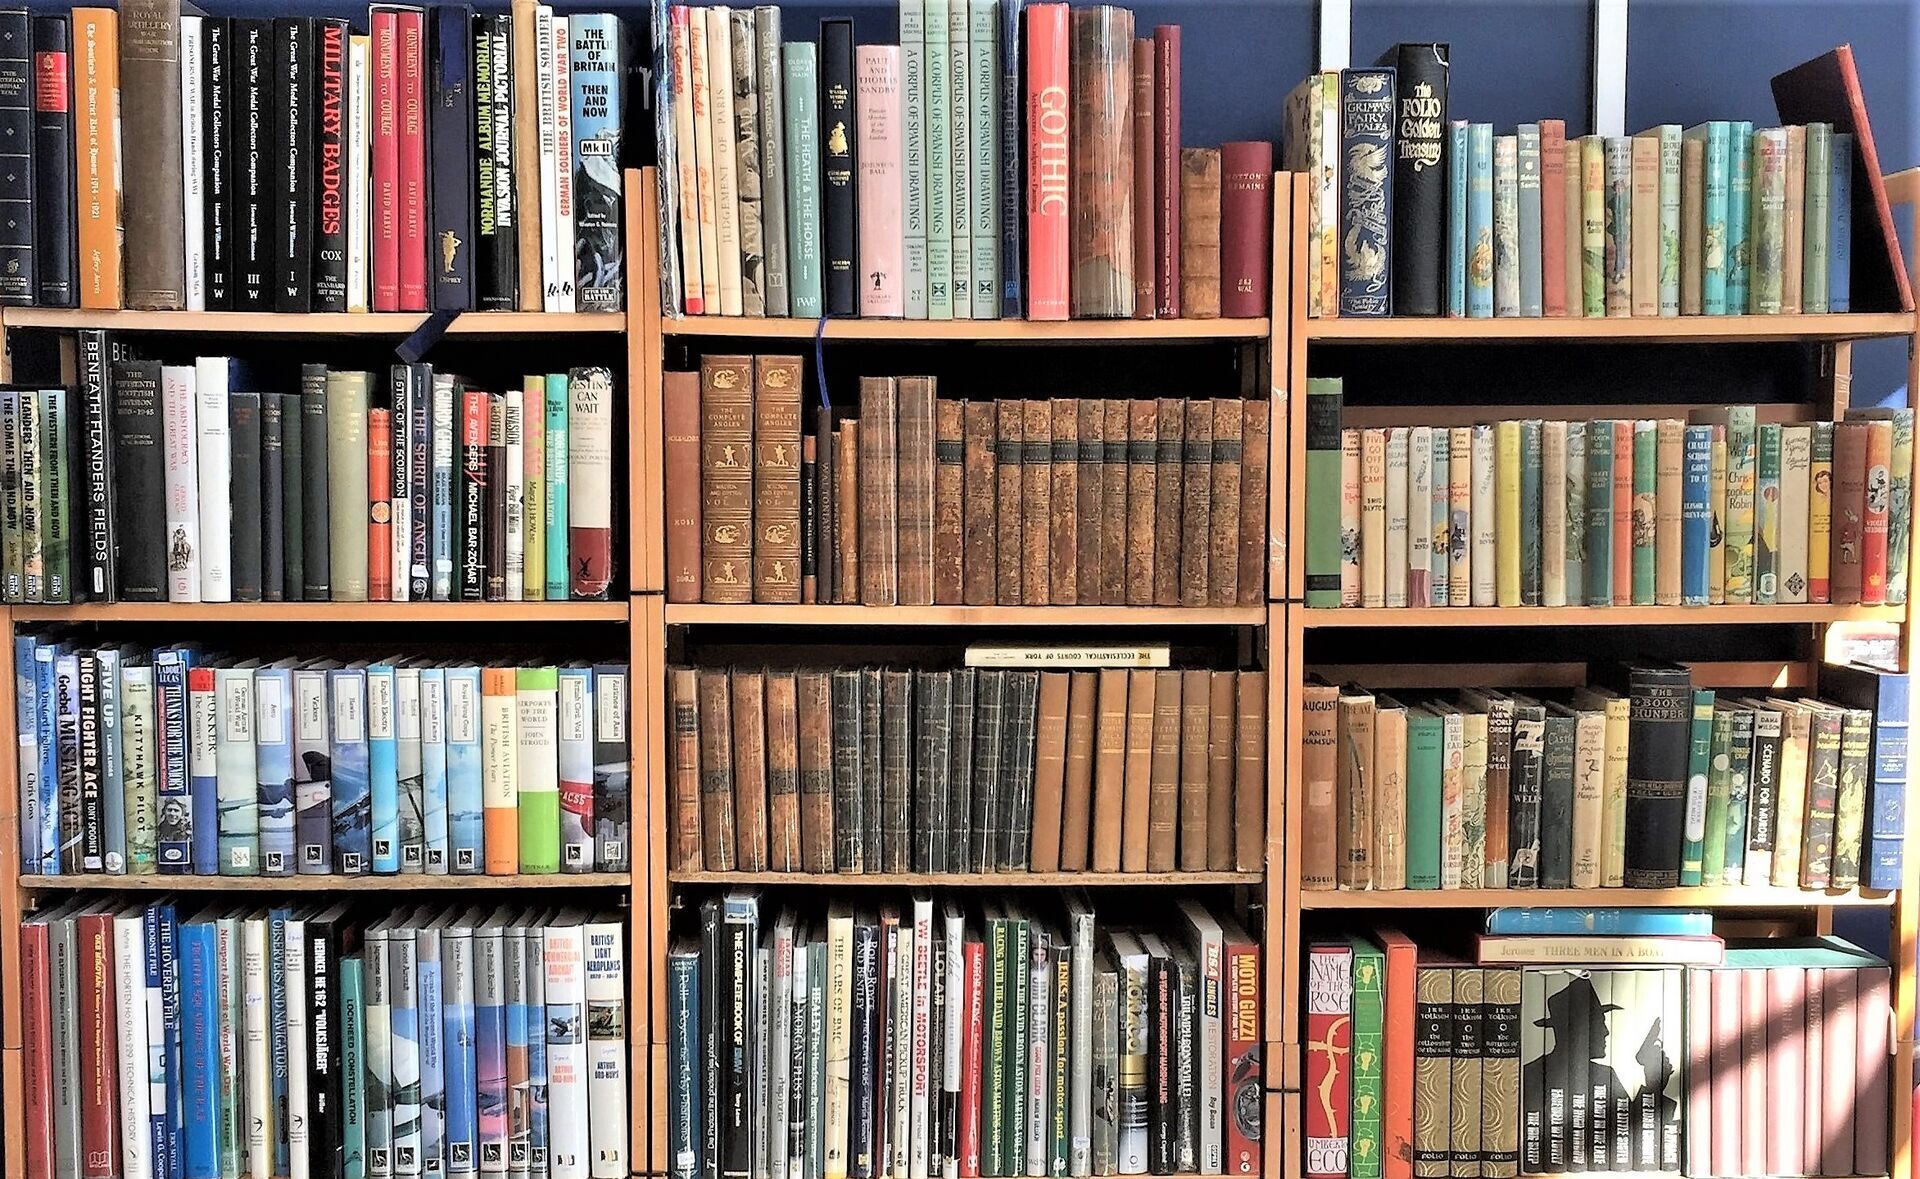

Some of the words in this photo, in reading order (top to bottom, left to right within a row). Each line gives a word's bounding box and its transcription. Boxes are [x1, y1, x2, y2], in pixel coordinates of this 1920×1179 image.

[540, 15, 549, 67] SOLDIER
[557, 29, 566, 49] TWO
[584, 29, 603, 39] THE
[476, 31, 490, 103] MEMORIAL
[494, 32, 508, 102] PICTORIAL
[558, 54, 566, 74] WAR
[574, 62, 615, 72] BRITAIN
[588, 51, 600, 60] OF
[323, 28, 341, 135] MILITARY
[582, 85, 608, 94] THEN
[908, 60, 918, 102] CORPUS
[1415, 81, 1431, 97] The
[542, 74, 551, 124] BRITISH
[558, 79, 567, 111] WORLD
[585, 96, 606, 105] AND
[1402, 98, 1441, 117] FOLIO
[559, 116, 568, 127] OF
[583, 108, 607, 117] NOW
[908, 106, 918, 117] OF
[1349, 113, 1385, 124] FAIRY
[479, 105, 492, 150] ALBUM
[496, 106, 509, 166] JOURNAL
[800, 119, 810, 140] THE
[1357, 123, 1387, 131] TALES
[1402, 118, 1442, 138] Golden
[544, 130, 552, 152] THE
[559, 131, 568, 173] SOLDIERS
[583, 143, 600, 153] Mk
[909, 122, 918, 166] SPANISH
[1040, 86, 1067, 216] GOTHIC
[801, 144, 811, 181] HEATH
[1399, 140, 1441, 171] Treasury
[213, 150, 221, 194] Companion
[324, 144, 340, 233] BADGES
[480, 157, 494, 235] NORMANDIE
[497, 168, 510, 226] INVASION
[560, 177, 569, 216] GERMAN
[910, 171, 919, 229] DRAWINGS
[804, 197, 812, 218] THE
[802, 222, 813, 259] HORSE
[321, 251, 342, 260] COX
[88, 342, 101, 414] BENEATH
[396, 382, 404, 410] STING
[469, 396, 477, 414] THE
[575, 403, 599, 413] WAIT
[578, 392, 598, 401] CAN
[22, 396, 32, 444] FLANDERS
[396, 413, 404, 425] OF
[415, 407, 426, 435] THE
[507, 406, 519, 445] INVASION
[468, 418, 477, 471] AVENGERS
[24, 451, 33, 474] THEN
[91, 420, 104, 502] FLANDERS
[415, 442, 426, 487] SPIRIT
[25, 482, 34, 501] AND
[415, 493, 426, 513] OF
[468, 482, 478, 524] MICHAEL
[1730, 498, 1751, 509] Robin
[25, 508, 34, 530] NOW
[94, 509, 106, 560] FIELDS
[82, 658, 94, 701] NIGHT
[102, 662, 112, 700] FIVE
[58, 675, 72, 716] Goebel
[166, 686, 183, 719] THANKS
[1303, 701, 1335, 711] AUGUST
[1641, 699, 1679, 707] BOOK
[104, 704, 114, 727] UP
[1635, 709, 1684, 718] HUNTER
[83, 708, 95, 766] FIGHTER
[167, 720, 183, 737] FOR
[61, 720, 78, 796] MUSTANG
[135, 713, 143, 788] KITTYHAWK
[168, 738, 183, 754] THE
[168, 756, 184, 791] MEMORY
[1761, 744, 1772, 784] SCENARIO
[27, 773, 35, 796] Chris
[85, 772, 97, 797] ACE
[1760, 788, 1769, 804] FOR
[160, 921, 171, 942] THE
[734, 931, 743, 950] THE
[919, 920, 927, 939] VW
[315, 938, 325, 974] HEINKEL
[835, 937, 843, 960] THE
[1543, 947, 1580, 956] THREE
[1584, 948, 1607, 956] MEN
[1612, 948, 1623, 956] IN
[273, 920, 284, 1008] OBSERVERS
[918, 945, 927, 990] BEETLE
[1208, 947, 1218, 976] BSA
[1310, 960, 1348, 980] NAME
[163, 946, 172, 1003] HOVERFLY
[315, 977, 326, 988] HE
[734, 951, 743, 1003] COMPLETE
[834, 964, 843, 994] CARS
[1058, 961, 1068, 997] JENKS:
[1239, 955, 1255, 995] MOTO
[1311, 981, 1324, 990] OF
[1327, 981, 1348, 991] THE
[316, 990, 326, 1006] 162
[834, 998, 842, 1012] OF
[917, 996, 926, 1007] in
[1059, 1000, 1067, 1009] A
[1207, 980, 1216, 1015] SINGLES
[1311, 991, 1348, 1012] ROSE
[165, 1005, 173, 1028] FILE
[275, 1011, 285, 1029] AND
[734, 1003, 743, 1031] BOOK
[1240, 1000, 1255, 1040] GUZZI
[734, 1032, 742, 1045] OF
[833, 1018, 841, 1042] BMC
[1057, 1012, 1067, 1054] passion
[276, 1031, 287, 1077] NAVIGATORS
[734, 1048, 742, 1073] BMW
[916, 1013, 926, 1097] MOTORSPORT
[1058, 1058, 1066, 1072] for
[1309, 1149, 1347, 1172] ECO
